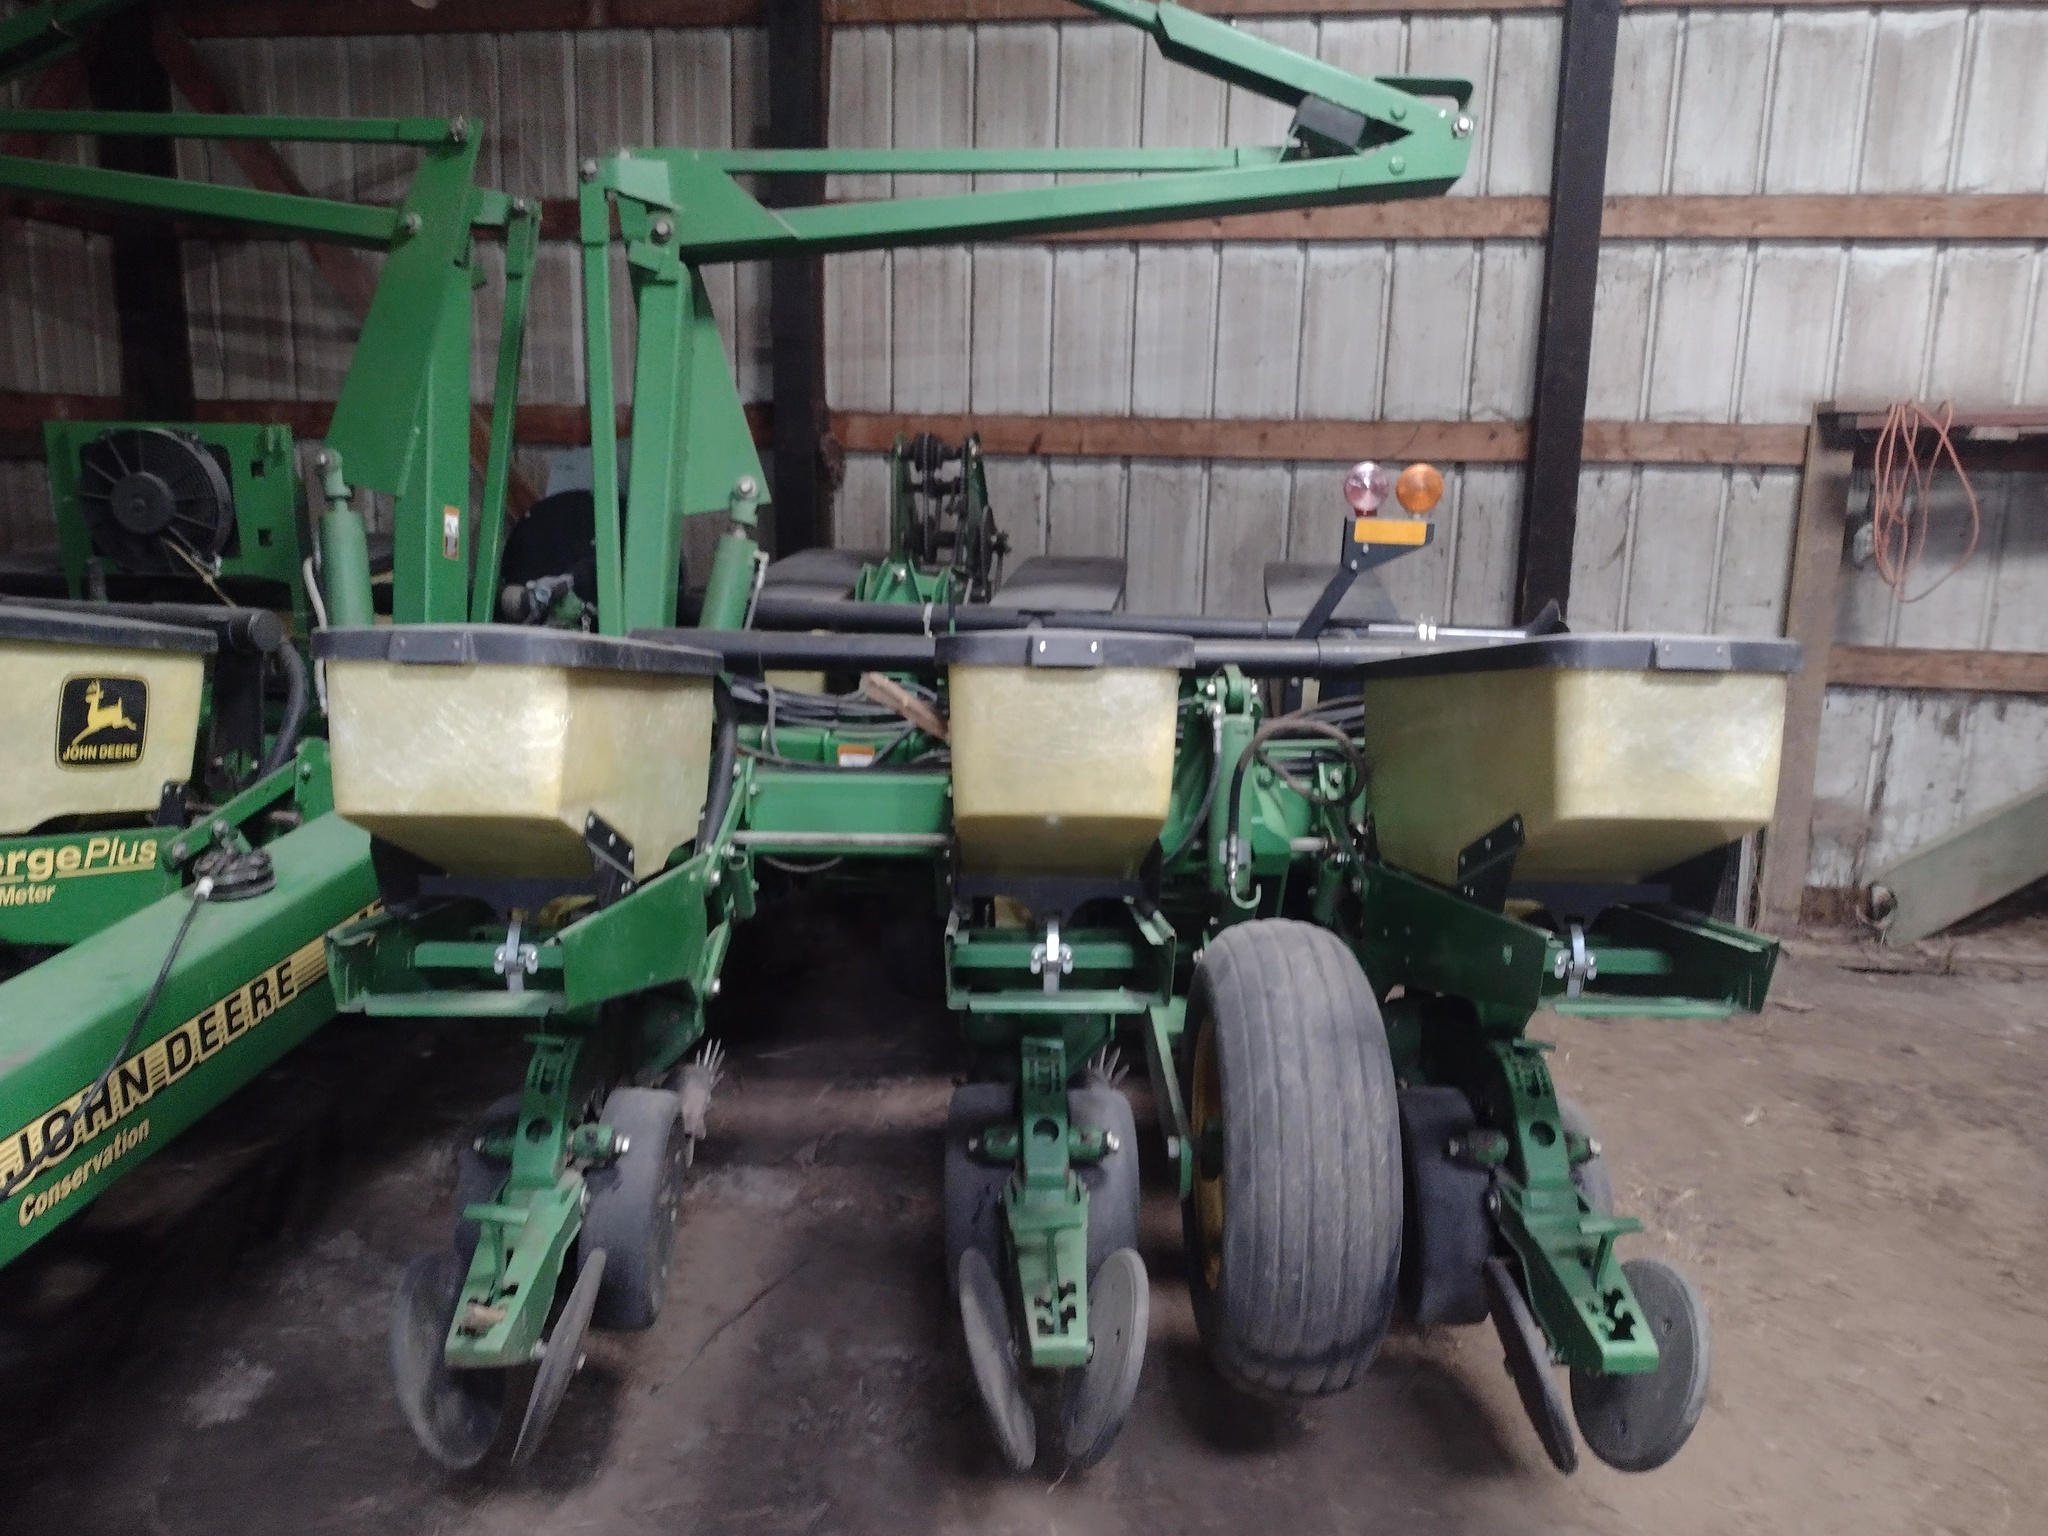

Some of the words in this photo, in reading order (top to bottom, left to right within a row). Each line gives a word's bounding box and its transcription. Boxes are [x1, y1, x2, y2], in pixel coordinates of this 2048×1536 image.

[63, 744, 97, 761] JOHN
[99, 743, 138, 759] DEERE
[0, 836, 158, 882] rgePlus
[5, 1056, 149, 1188] JOHN
[165, 961, 296, 1077] DEERE
[18, 1118, 150, 1227] Conservation
